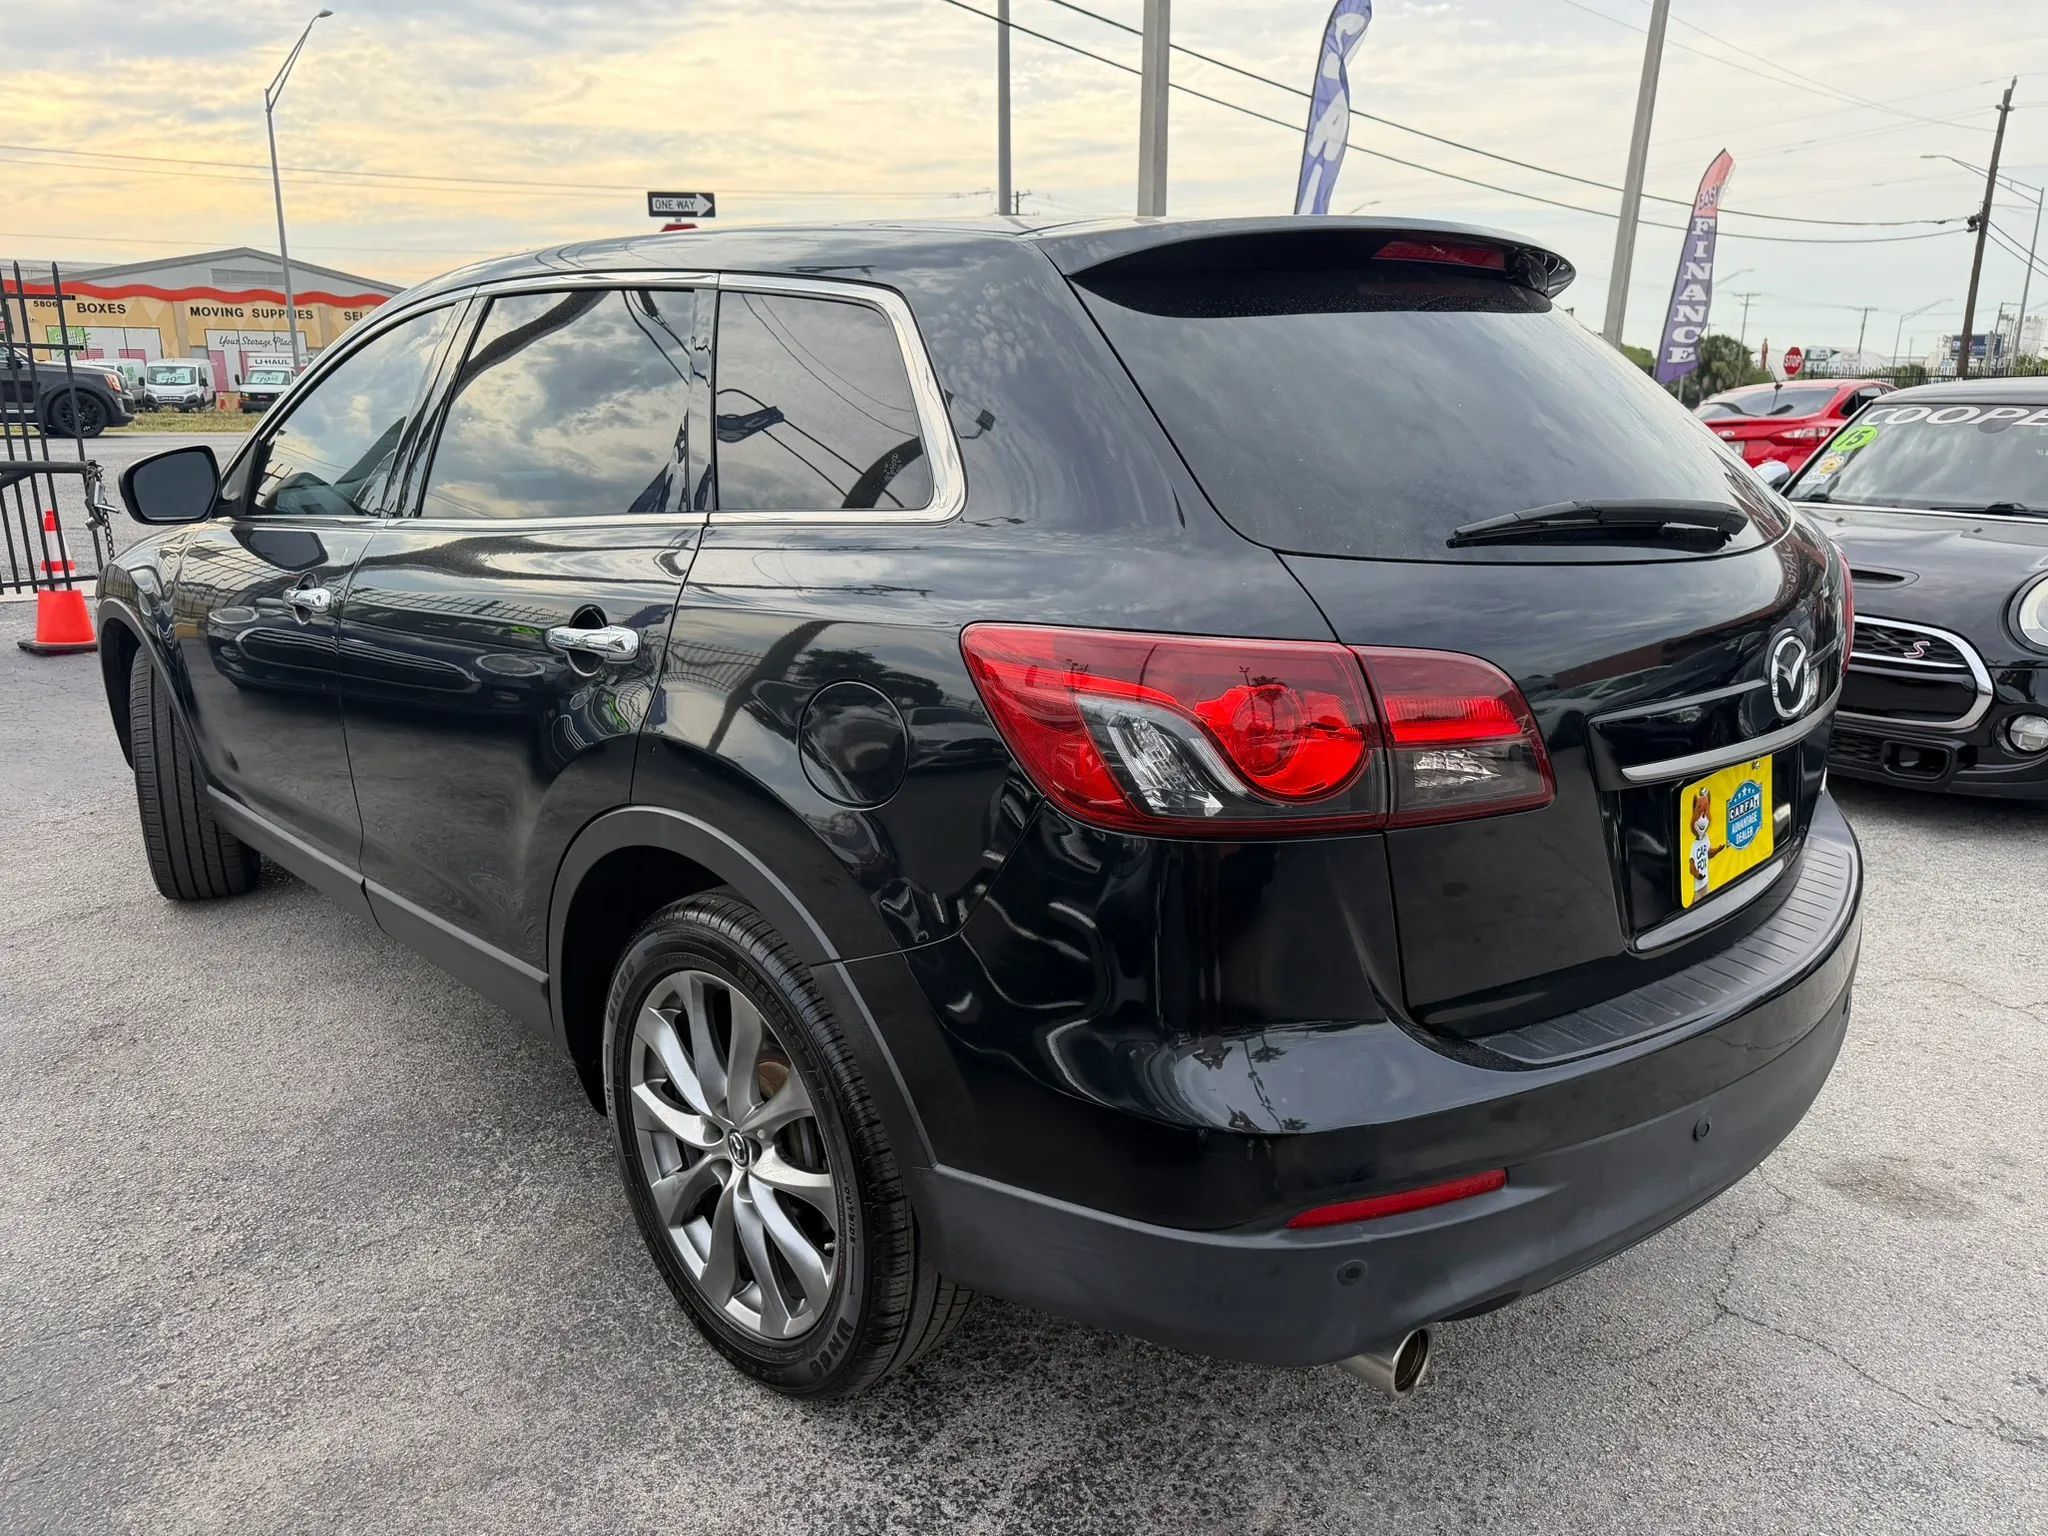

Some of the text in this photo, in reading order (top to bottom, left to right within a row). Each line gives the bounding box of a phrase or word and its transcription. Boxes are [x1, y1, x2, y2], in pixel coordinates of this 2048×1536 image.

[654, 199, 696, 210] ONE WAY
[1667, 217, 1715, 363] FINANCE
[33, 300, 58, 308] 5806
[76, 302, 127, 314] BOXES
[189, 306, 244, 318] MOVING
[219, 335, 292, 348] Your Storage Plac
[1785, 354, 1801, 367] STOP
[1836, 429, 1871, 446] 15
[1903, 640, 1931, 659] S
[1730, 793, 1760, 819] CARFAX
[1736, 826, 1754, 844] DEALER
